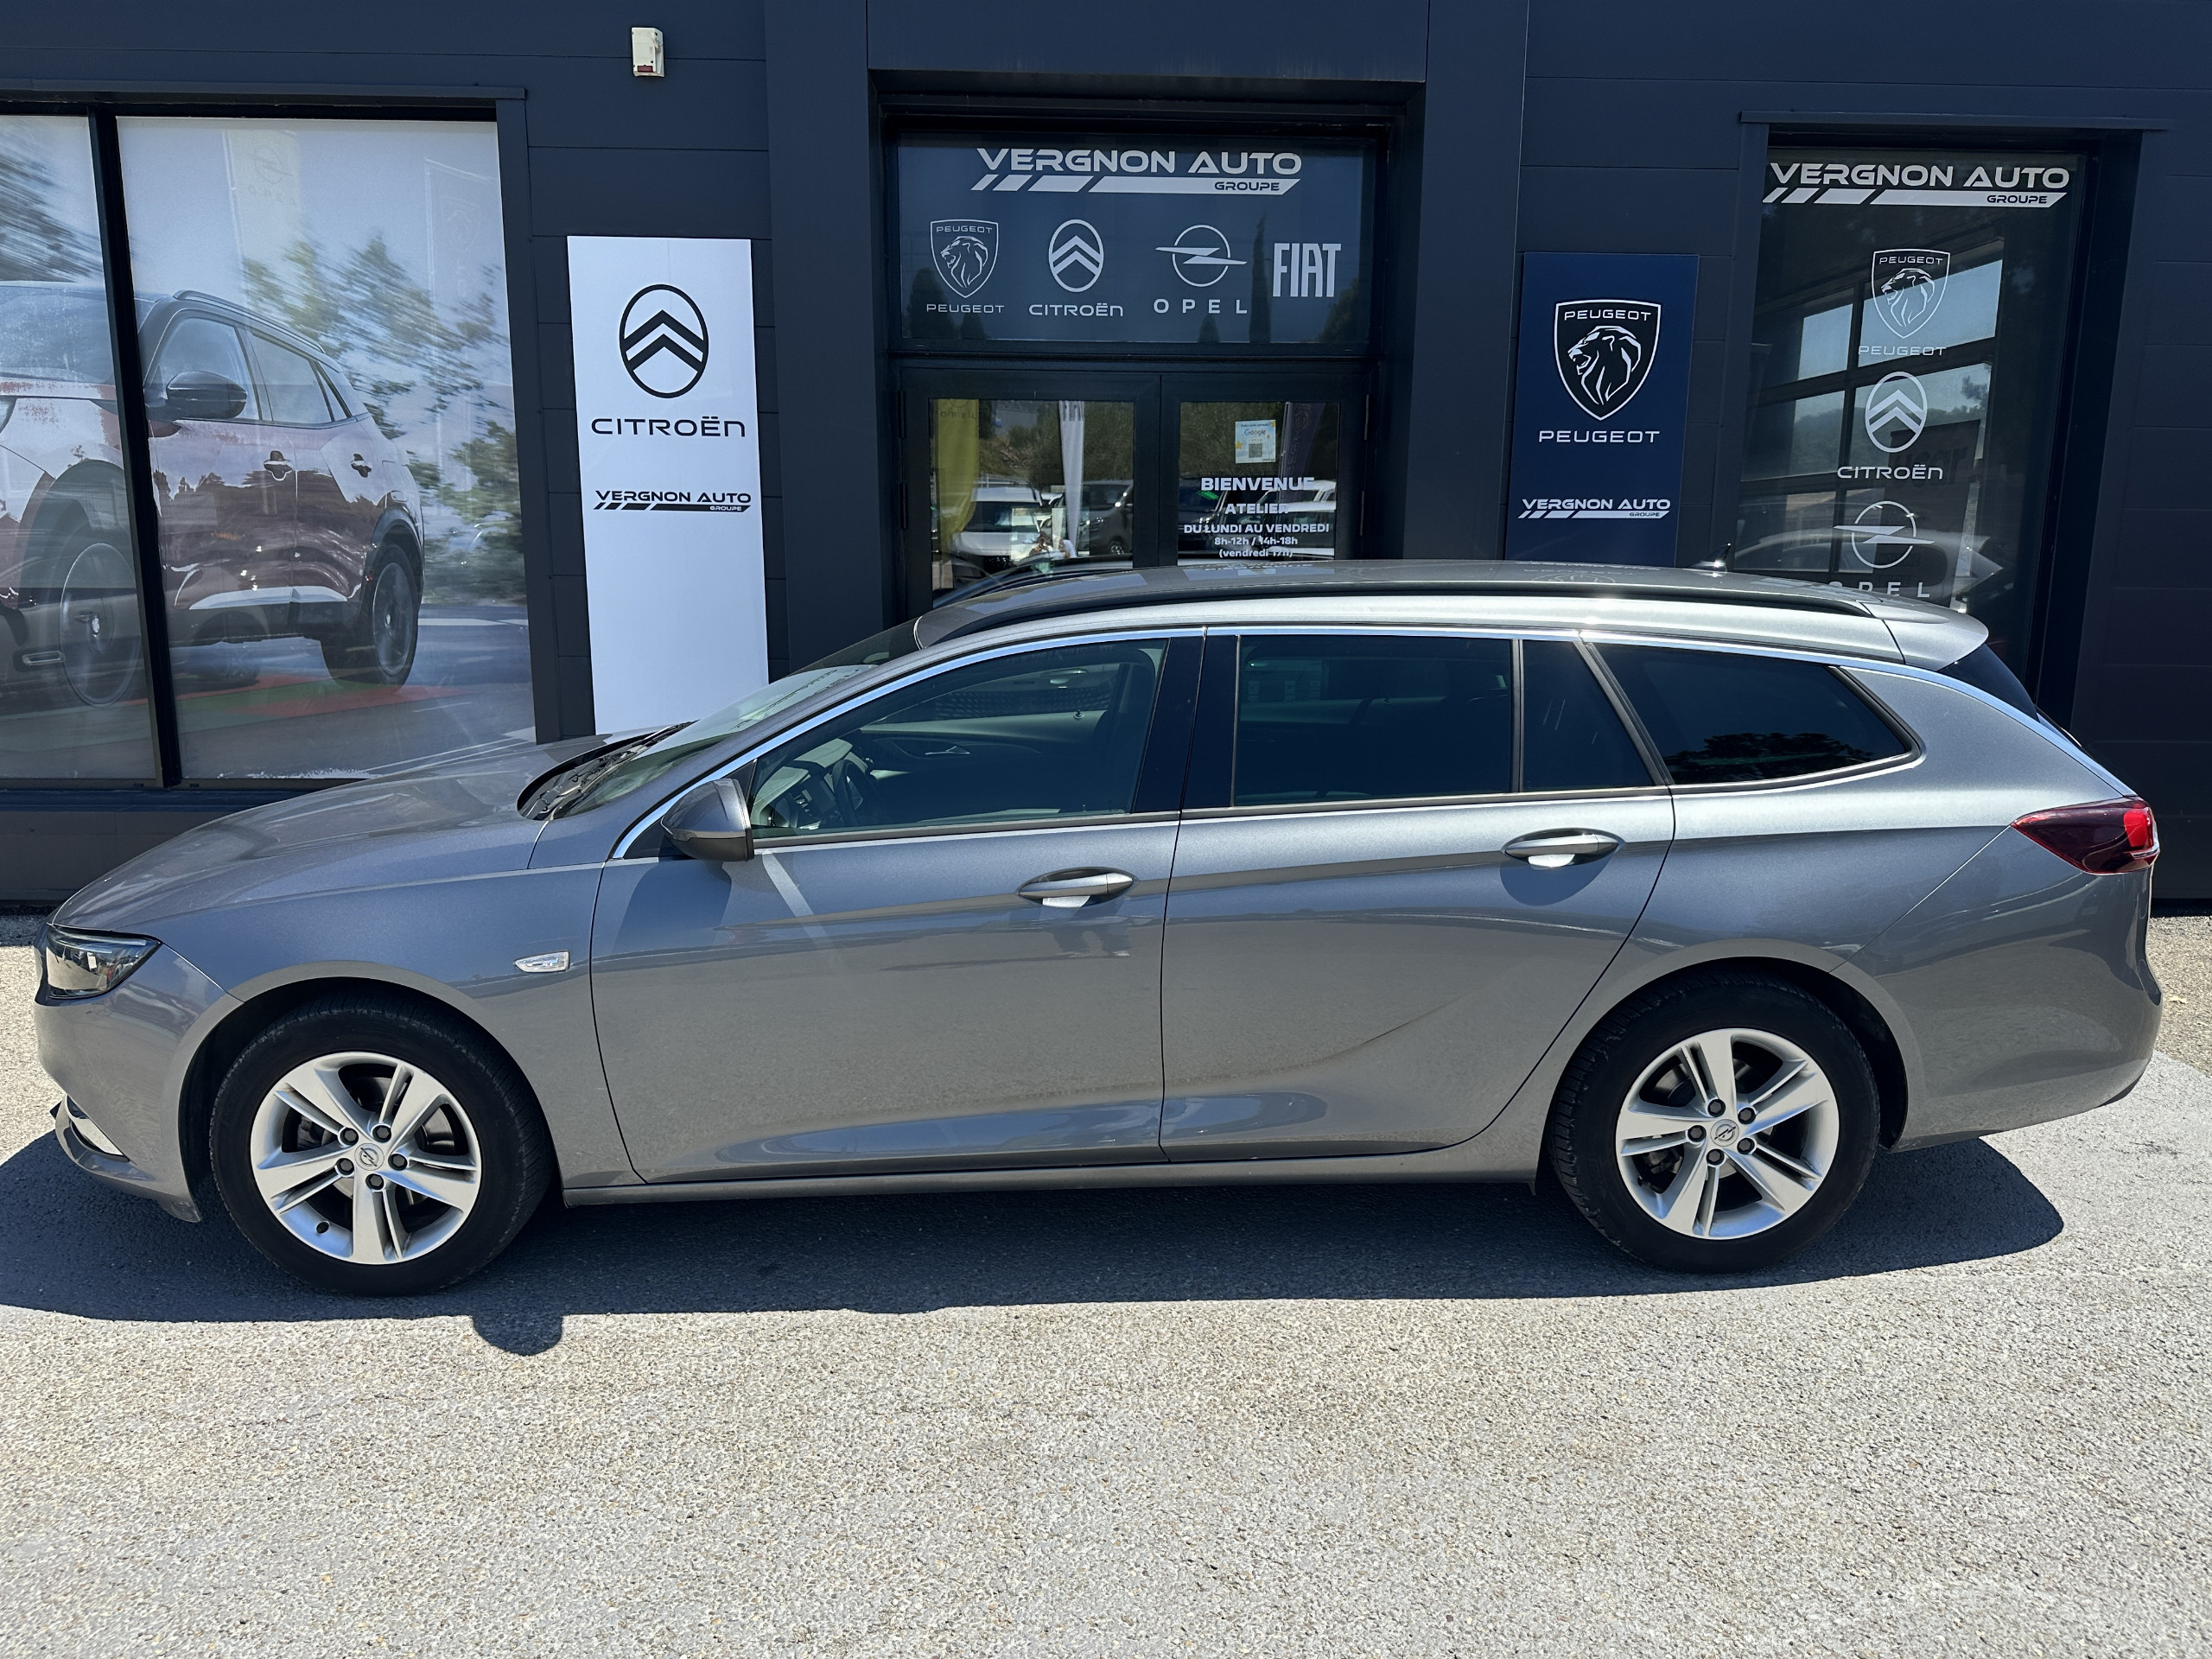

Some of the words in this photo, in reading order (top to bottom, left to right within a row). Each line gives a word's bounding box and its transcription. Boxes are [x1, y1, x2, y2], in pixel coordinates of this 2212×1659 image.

[976, 148, 1176, 173] VERGNON
[1187, 151, 1303, 175] AUTO
[1770, 162, 1954, 187] VERGNON
[1963, 166, 2070, 189] AUTO
[1214, 181, 1281, 192] GROUPE
[1986, 194, 2048, 205] GROUPE
[936, 224, 993, 234] PEUGEOT
[1878, 255, 1943, 265] PEUGEOT
[1273, 242, 1342, 298] FIAT
[926, 303, 1005, 315] PEUGEOT
[1153, 298, 1248, 315] OPEL
[1564, 308, 1651, 322] PEUGEOT
[1858, 346, 1947, 357] PEUGEOT
[1538, 430, 1661, 443] PEUGEOT
[1200, 477, 1315, 491] BIENVENUE
[595, 490, 690, 504] VERGNON
[696, 492, 752, 504] AUTO
[1224, 503, 1289, 515] ATELIER
[1522, 499, 1613, 510] VERGNON
[1618, 499, 1671, 510] AUTO
[1184, 524, 1202, 534] DU
[1205, 524, 1242, 533] LUNDI
[1244, 524, 1263, 533] AU
[1265, 524, 1330, 533] VENDREDI
[1214, 537, 1249, 545] 8h-12h
[1259, 537, 1299, 545] 14h-18h
[1218, 548, 1269, 558] (vendredi
